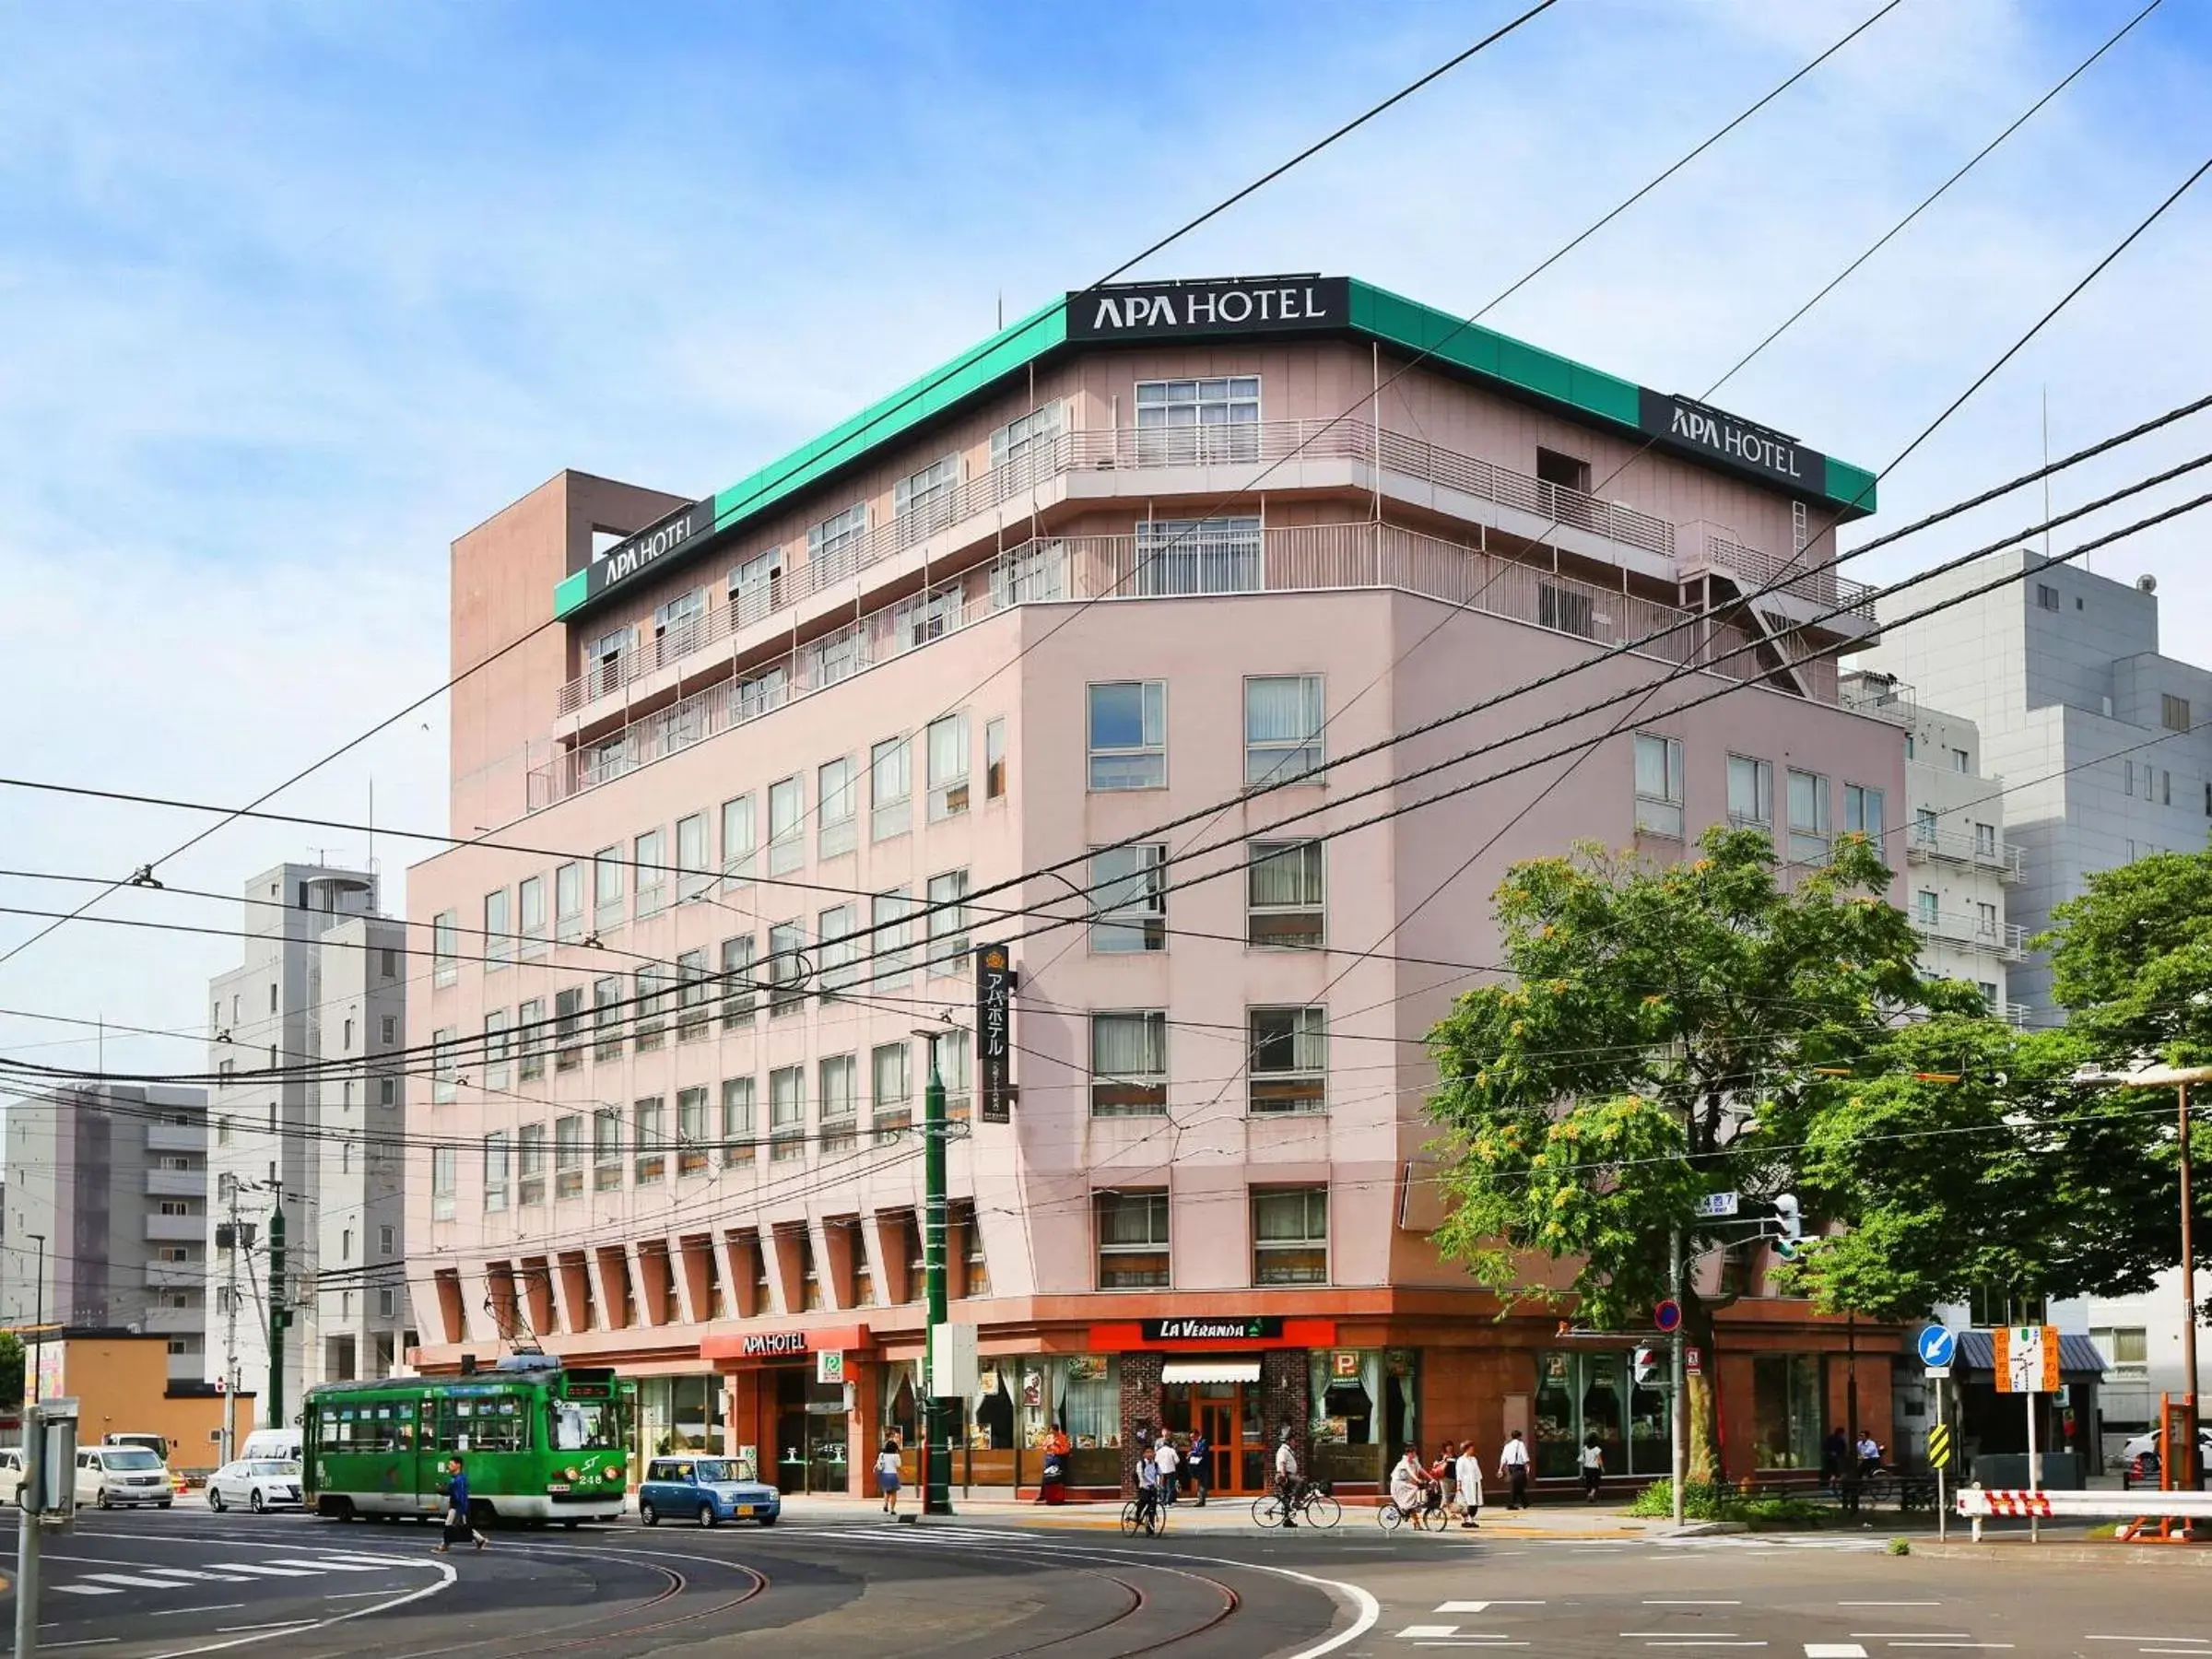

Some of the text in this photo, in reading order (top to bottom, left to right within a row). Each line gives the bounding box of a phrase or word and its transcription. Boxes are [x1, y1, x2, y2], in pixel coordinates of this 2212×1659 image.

[1093, 288, 1327, 330] APA HOTEL
[1671, 406, 1802, 478] APA HOTEL
[605, 547, 638, 586] APA
[987, 972, 1006, 1056] アパホテル
[742, 1333, 805, 1353] APA HOTEL
[1159, 1319, 1244, 1337] LA VERANDA
